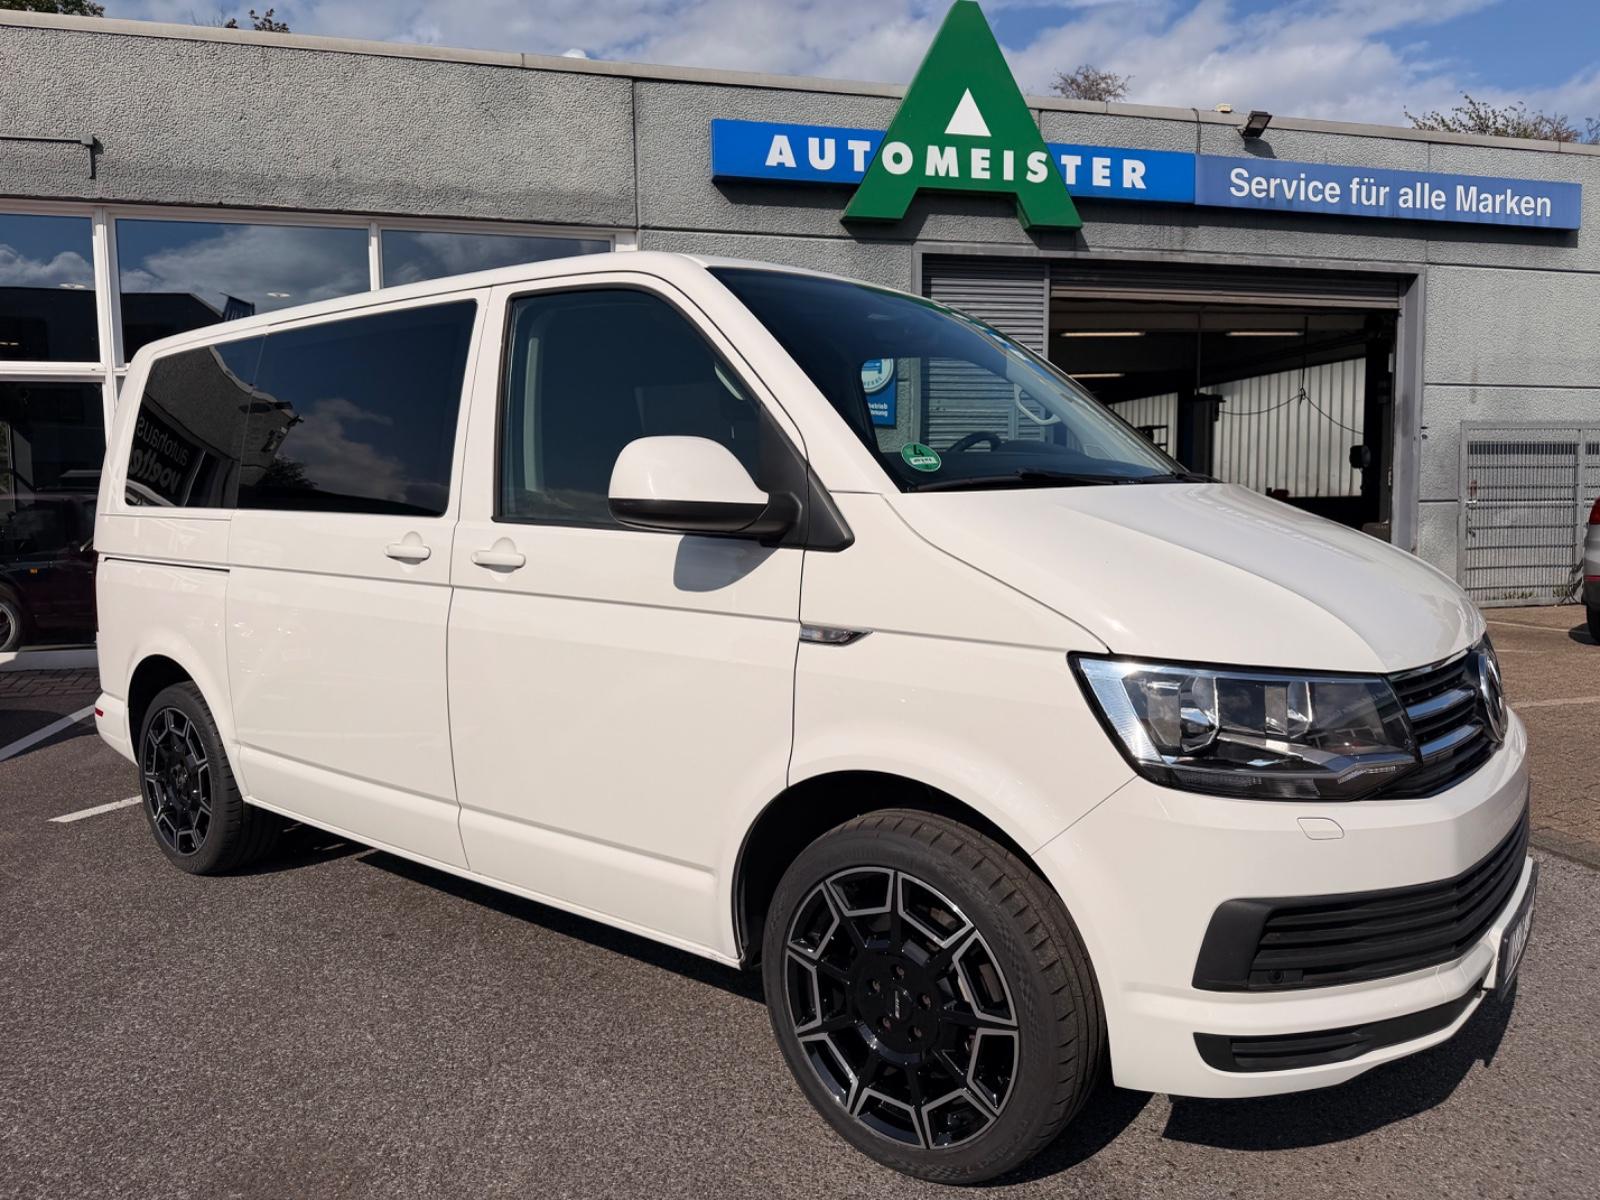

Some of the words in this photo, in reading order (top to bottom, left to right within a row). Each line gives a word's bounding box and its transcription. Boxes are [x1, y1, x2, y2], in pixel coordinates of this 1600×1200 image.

[765, 135, 1147, 189] AUTOMEISTER
[1229, 167, 1341, 204] Service
[1349, 177, 1390, 207] für
[1398, 182, 1447, 211] alle
[1455, 185, 1552, 218] Marken
